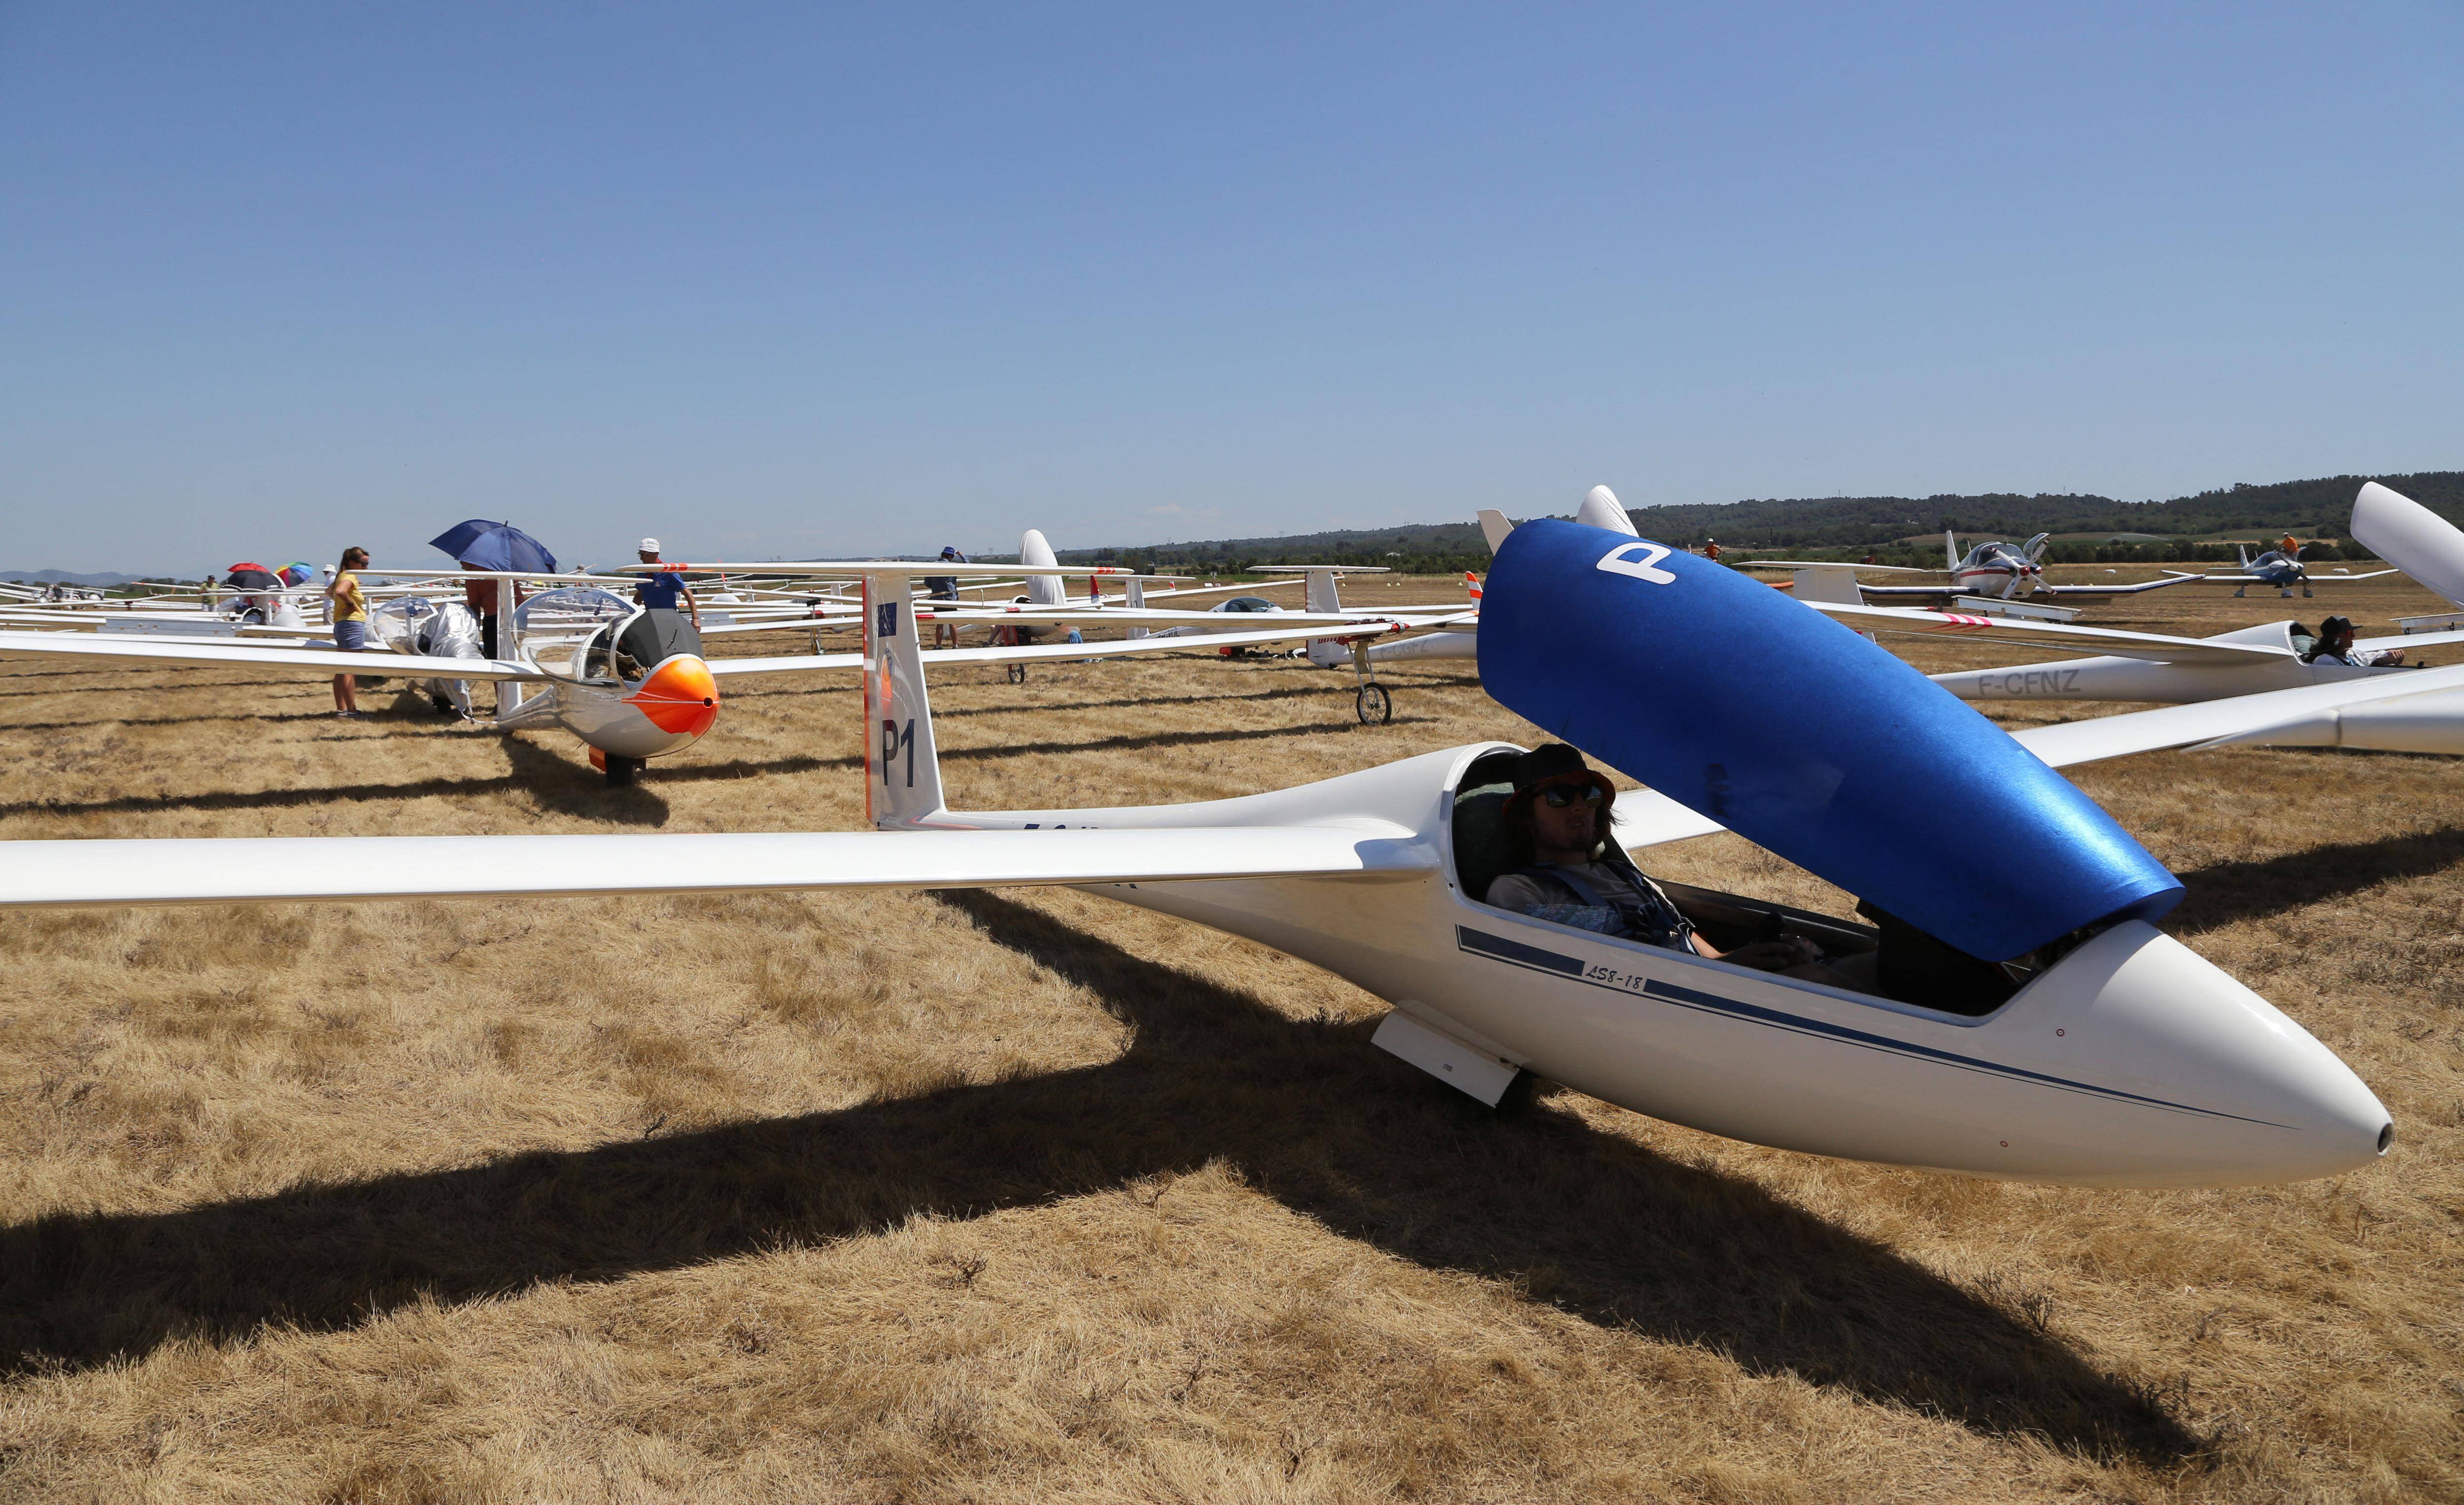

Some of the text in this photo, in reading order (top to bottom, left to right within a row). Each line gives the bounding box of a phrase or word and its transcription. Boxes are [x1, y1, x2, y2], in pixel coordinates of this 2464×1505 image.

[1596, 542, 1676, 584] P
[1979, 669, 2081, 695] F-CFNZ
[882, 719, 915, 787] P1
[1585, 965, 1643, 989] LS8-18
